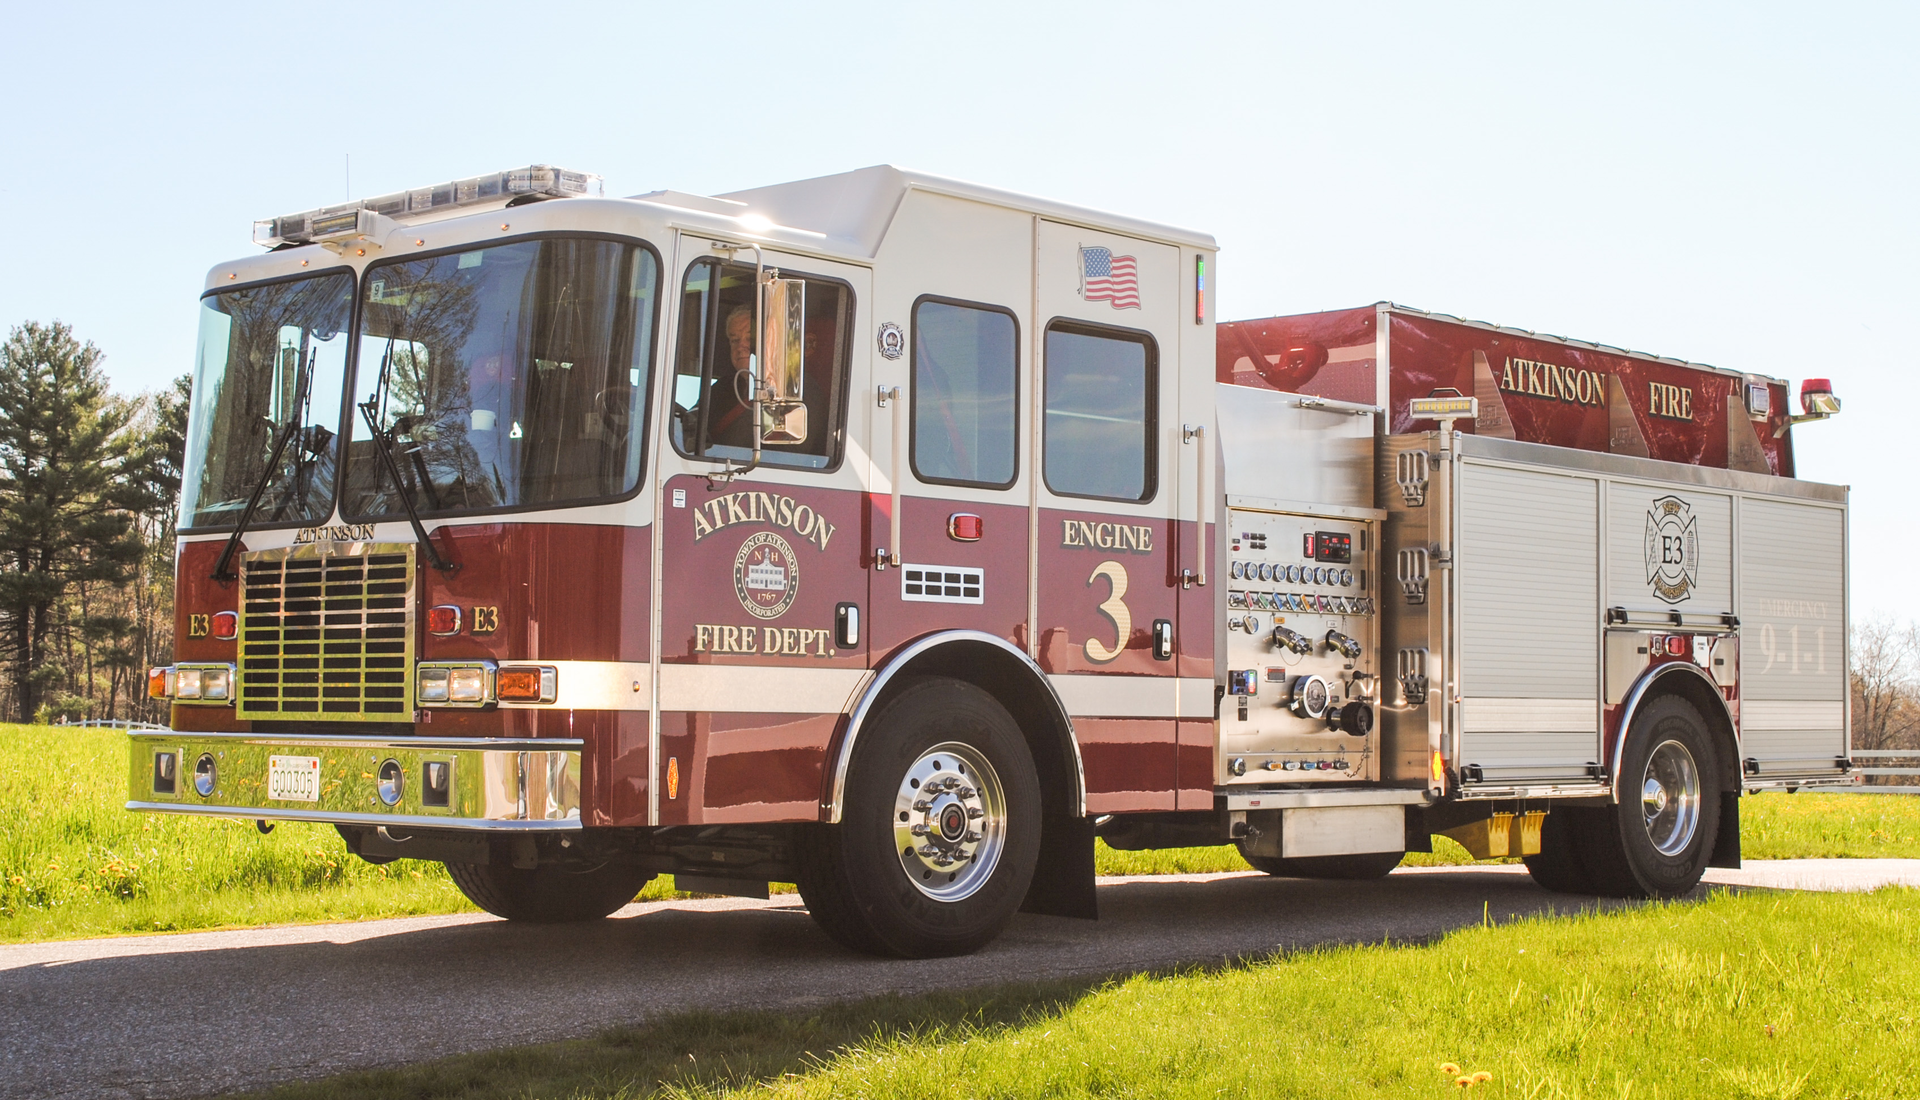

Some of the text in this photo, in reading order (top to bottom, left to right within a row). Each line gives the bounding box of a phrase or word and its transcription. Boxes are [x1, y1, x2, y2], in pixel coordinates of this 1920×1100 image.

[1500, 355, 1693, 420] ATKINSON FIRE
[293, 522, 376, 544] ATKINSON
[693, 491, 836, 551] ATKINSON
[1062, 519, 1153, 551] ENGINE
[735, 533, 797, 576] TOWN OF ATKINSON
[754, 551, 779, 562] N H
[1661, 535, 1683, 564] E3
[743, 599, 786, 617] INCORPORATED
[757, 592, 776, 603] 1767
[1085, 560, 1132, 661] 3
[1759, 598, 1828, 619] EMERGENCY
[189, 613, 210, 637] E3
[472, 606, 499, 632] E3
[694, 624, 835, 656] FIRE DEPT.
[1760, 623, 1828, 675] 9-1-1
